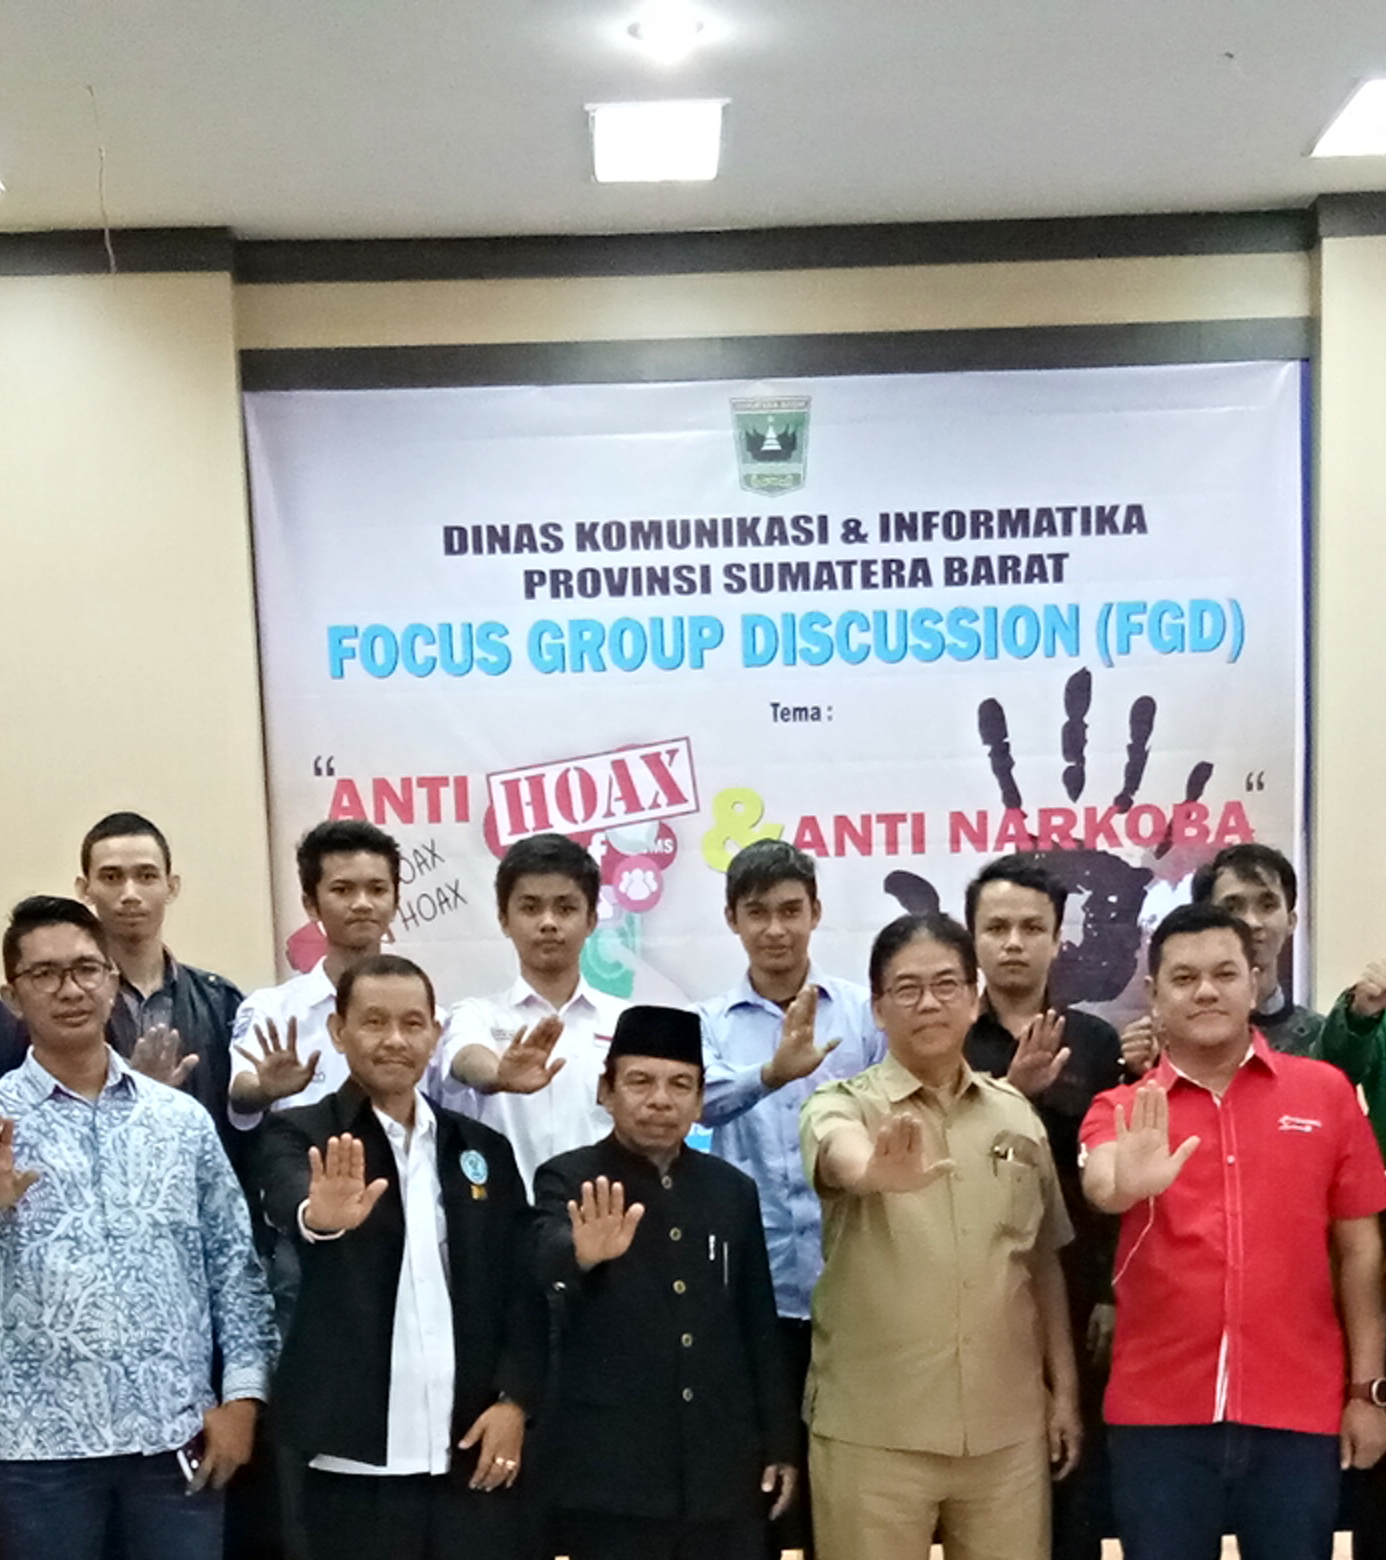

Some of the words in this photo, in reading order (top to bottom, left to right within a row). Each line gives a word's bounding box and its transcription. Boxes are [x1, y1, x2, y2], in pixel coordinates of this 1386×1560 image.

[443, 522, 564, 556] DINAS
[575, 514, 830, 552] KOMUNIKASI
[841, 518, 869, 544] &
[879, 504, 1148, 543] INFORMATIKA
[523, 565, 712, 600] PROVINSI
[722, 556, 934, 594] SUMATERA
[943, 553, 1070, 588] BARAT
[327, 622, 513, 679] FOCUS
[527, 615, 725, 674] GROUP
[740, 603, 1081, 670] DISCUSSION
[1095, 598, 1246, 668] (FGD)
[770, 703, 822, 722] Tema
[500, 748, 690, 837] HOAX
[702, 788, 784, 872] &
[793, 812, 926, 858] ANTI
[398, 838, 446, 885] OAX
[397, 878, 468, 932] HOAX
